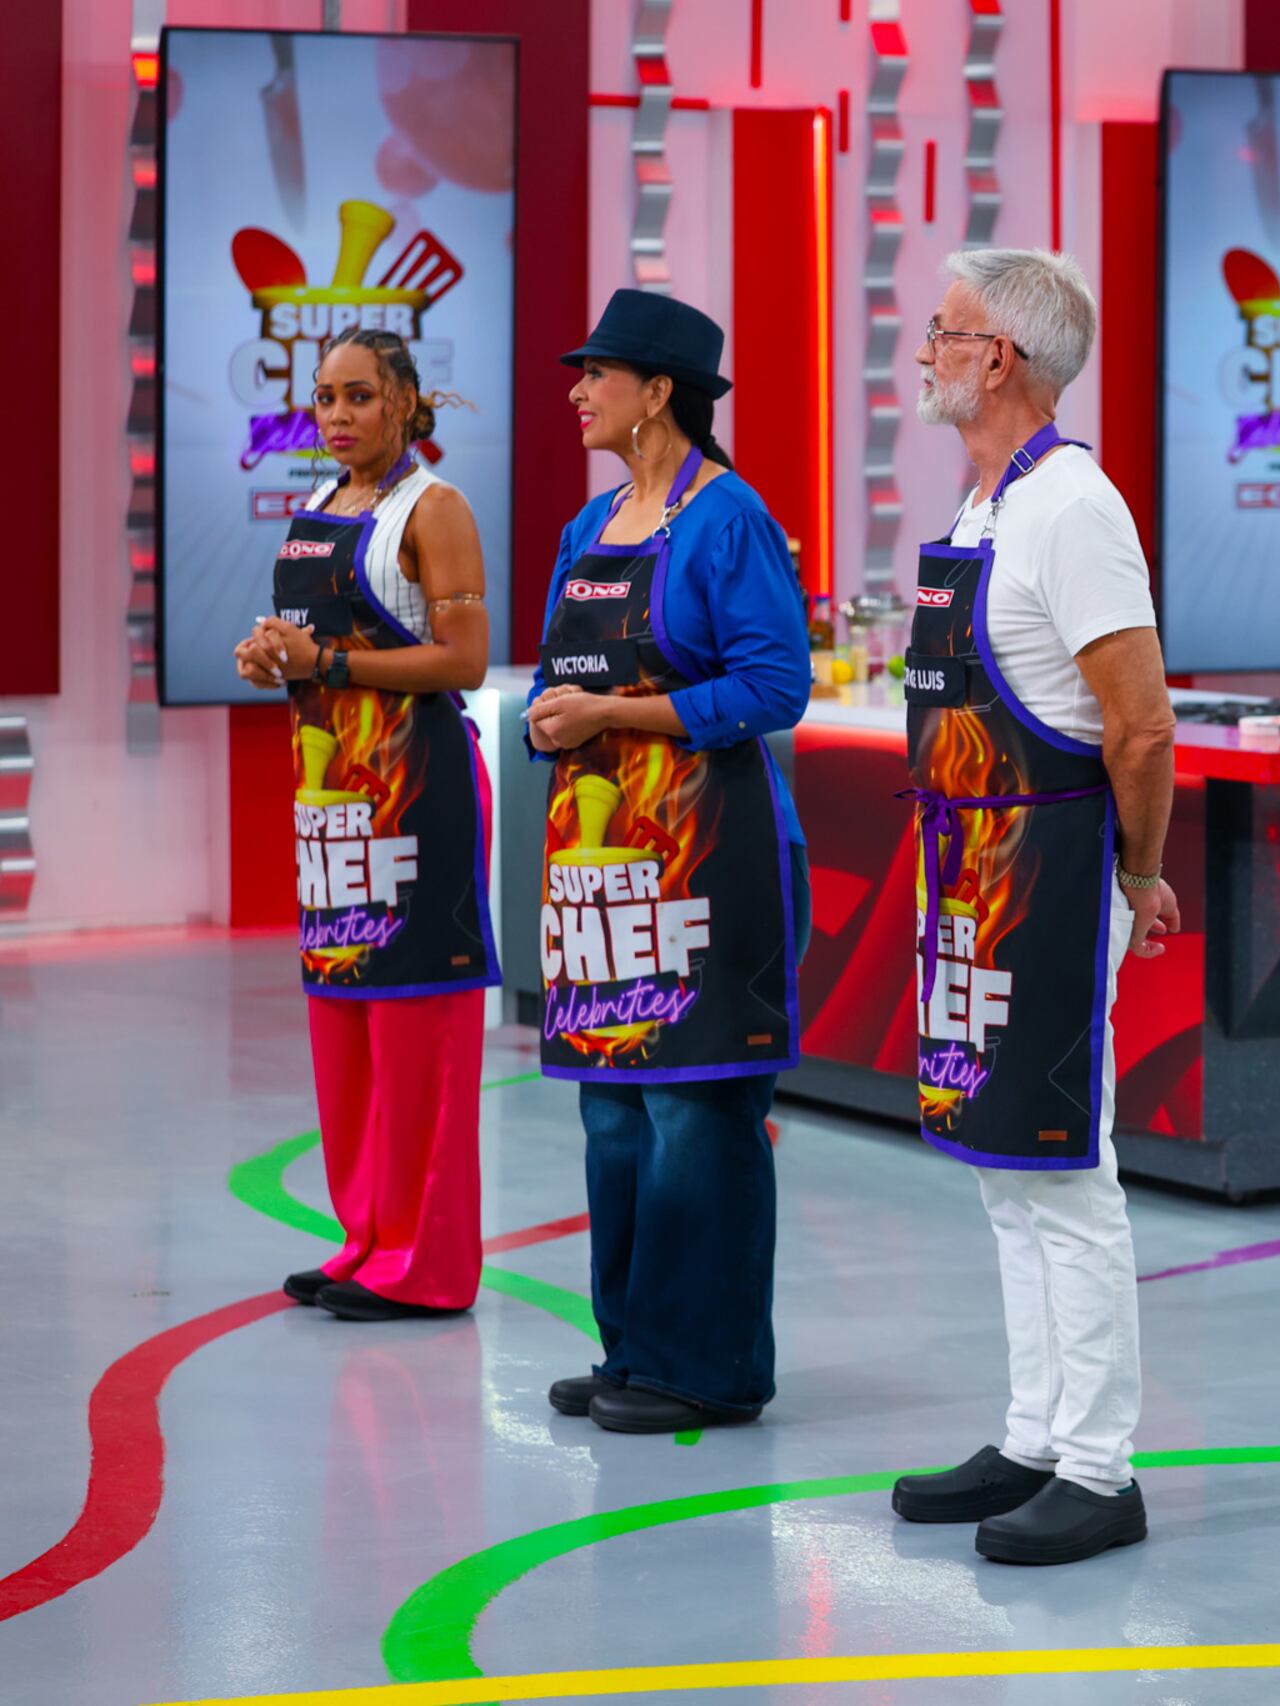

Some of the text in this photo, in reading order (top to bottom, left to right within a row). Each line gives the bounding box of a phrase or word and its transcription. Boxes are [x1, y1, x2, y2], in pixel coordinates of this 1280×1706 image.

[270, 303, 414, 340] SUPER
[551, 654, 609, 676] VICTORIA
[917, 669, 945, 691] LUIS
[296, 834, 418, 909] HEF
[550, 860, 660, 903] SUPER
[540, 897, 710, 981] CHEF
[544, 978, 696, 1040] Celebrities
